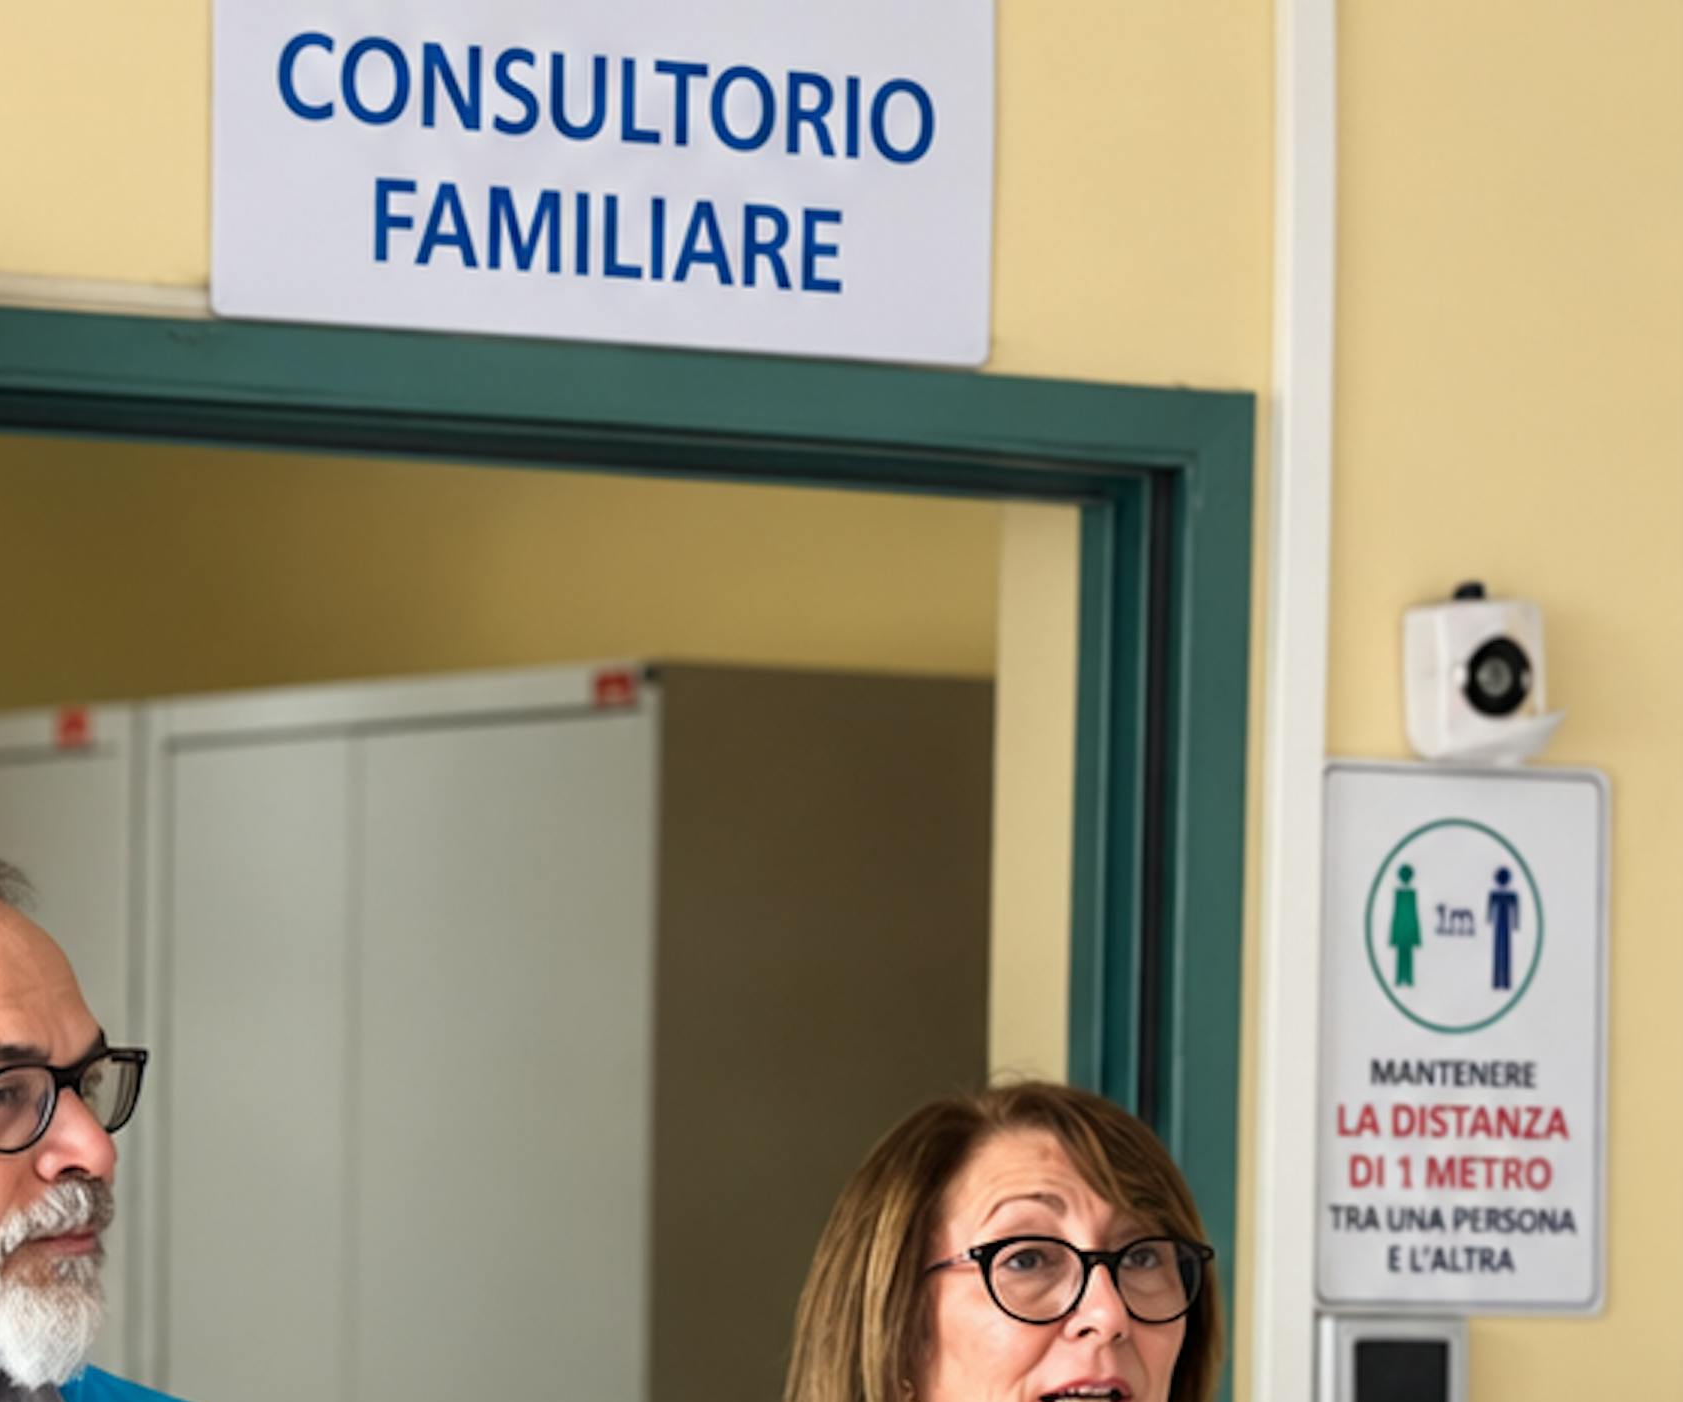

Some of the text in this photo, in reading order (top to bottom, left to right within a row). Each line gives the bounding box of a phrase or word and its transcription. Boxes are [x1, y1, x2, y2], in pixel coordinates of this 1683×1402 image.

[277, 31, 936, 165] CONSULTORIO
[372, 177, 843, 294] FAMILIARE
[1371, 1058, 1536, 1089] MANTENERE
[1336, 1103, 1570, 1141] LA DISTANZA
[1349, 1154, 1553, 1191] DI 1 METRO
[1329, 1204, 1577, 1235] TRA UNA PERSONA
[1388, 1246, 1515, 1274] E L'ALTRA
